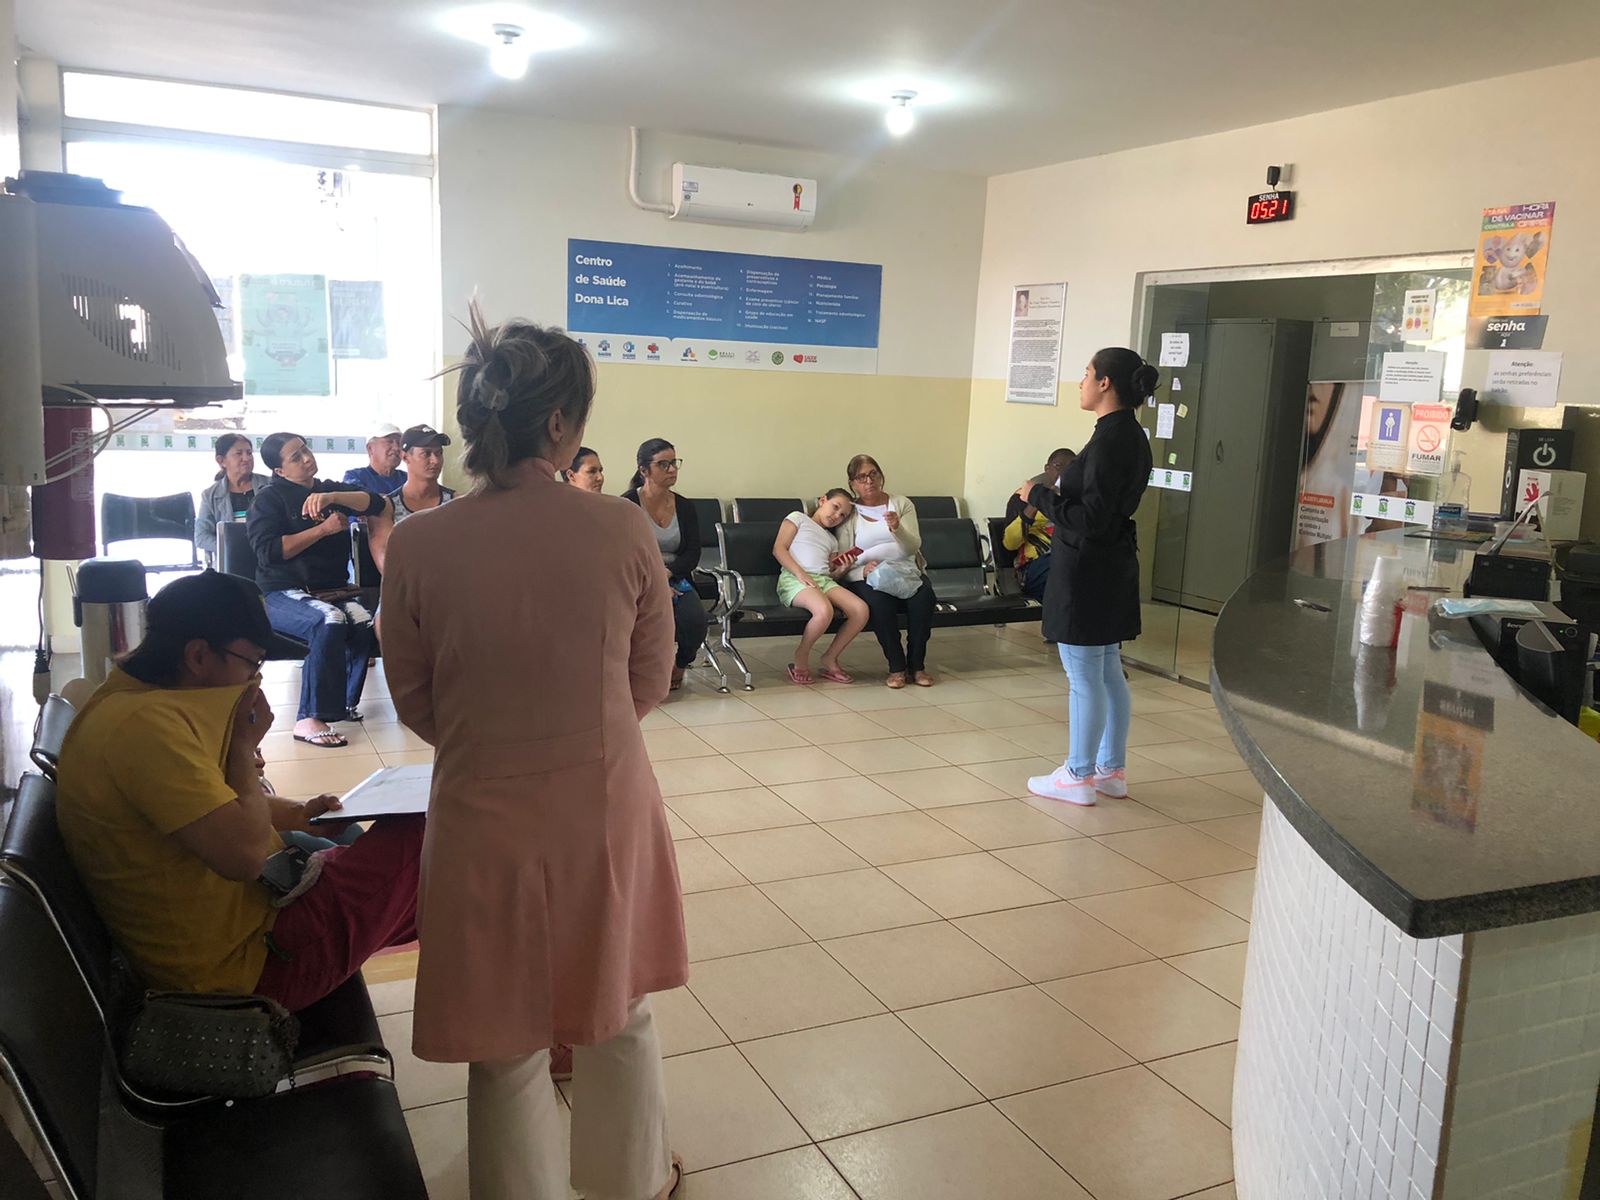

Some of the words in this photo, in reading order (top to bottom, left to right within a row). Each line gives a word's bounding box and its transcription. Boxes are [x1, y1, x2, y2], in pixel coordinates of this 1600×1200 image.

[1250, 200, 1287, 219] 0521
[1522, 203, 1550, 212] HORA
[1504, 212, 1544, 222] VACINAR
[575, 254, 612, 267] Centro
[575, 274, 589, 284] de
[592, 275, 626, 287] Saúde
[575, 293, 604, 305] Dona
[607, 296, 629, 306] Lica
[1487, 320, 1526, 332] senha
[1415, 409, 1448, 419] PROIBIDO
[1412, 453, 1441, 462] FUMAR
